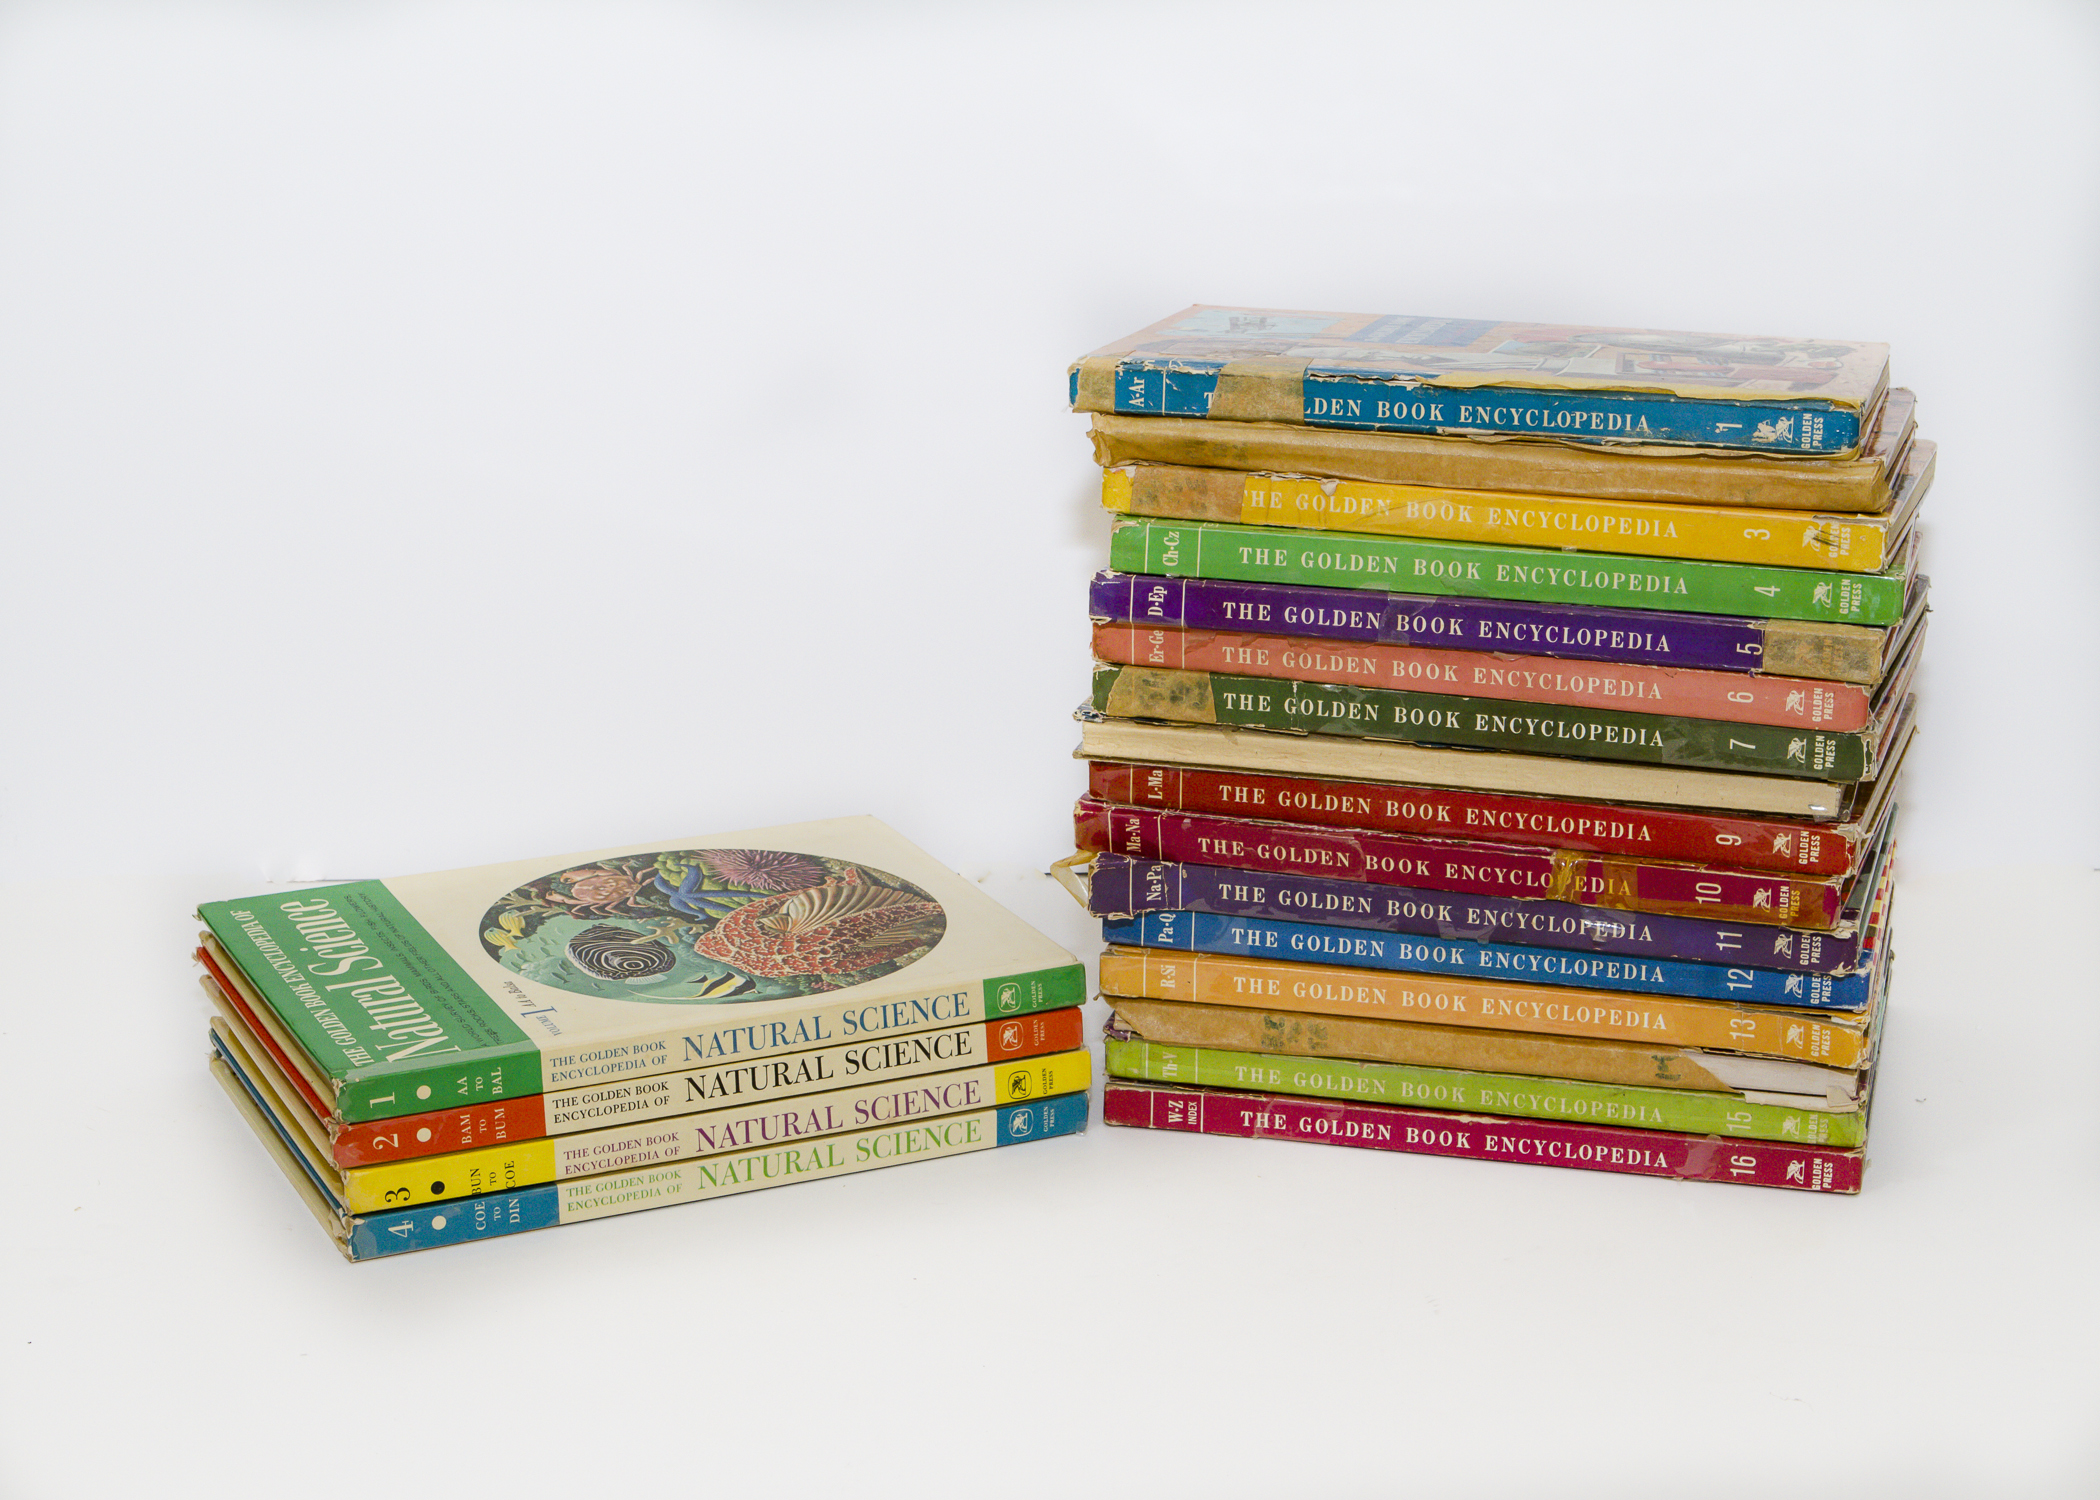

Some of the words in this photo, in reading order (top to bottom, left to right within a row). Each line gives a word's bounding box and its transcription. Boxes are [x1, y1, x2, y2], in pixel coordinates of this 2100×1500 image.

[1377, 401, 1444, 421] BOOK
[1460, 405, 1649, 432] ENCYCLOPEDIA
[1801, 412, 1813, 450] GOLDEN
[1812, 417, 1824, 449] PRESS
[1296, 494, 1391, 516] GOLDEN
[1407, 501, 1474, 522] BOOK
[1488, 507, 1678, 538] ENCYCLOPEDIA
[1743, 528, 1771, 541] 3
[1840, 527, 1851, 556] PRESS
[1239, 547, 1288, 567] THE
[1301, 551, 1399, 574] GOLDEN
[1414, 558, 1482, 580] BOOK
[1496, 564, 1688, 595] ENCYCLOPEDIA
[1754, 585, 1781, 597] 4
[1839, 579, 1851, 615] GOLDEN
[1850, 583, 1862, 612] PRESS
[1222, 602, 1271, 621] THE
[1284, 606, 1381, 630] GOLDEN
[1396, 614, 1463, 636] BOOK
[1478, 620, 1670, 652] ENCYCLOPEDIA
[1736, 643, 1763, 656] 5
[1222, 646, 1269, 666] THE
[1282, 652, 1377, 675] GOLDEN
[1392, 660, 1459, 682] BOOK
[1473, 668, 1662, 700] ENCYCLOPEDIA
[1727, 691, 1754, 704] 6
[1812, 687, 1823, 722] GOLDEN
[1823, 692, 1834, 720] PRESS
[1223, 693, 1271, 712] THE
[1284, 698, 1379, 721] GOLDEN
[1394, 705, 1461, 729] BOOK
[1475, 714, 1664, 747] ENCYCLOPEDIA
[1729, 738, 1756, 750] 7
[1813, 735, 1825, 770] GOLDEN
[1825, 739, 1836, 768] PRESS
[1219, 785, 1266, 805] THE
[1278, 790, 1371, 815] GOLDEN
[1386, 800, 1452, 822] BOOK
[1465, 808, 1652, 841] ENCYCLOPEDIA
[1715, 833, 1742, 846] 9
[1799, 830, 1810, 865] GOLDEN
[1810, 834, 1821, 863] PRESS
[1197, 837, 1245, 856] THE
[1257, 843, 1350, 868] GOLDEN
[1366, 855, 1431, 876] BOOK
[1445, 863, 1632, 896] ENCYCLOEDIA
[1695, 882, 1722, 904] 10
[1778, 885, 1790, 919] GOLDEN
[1790, 889, 1801, 917] PRESS
[230, 911, 254, 921] OF
[1219, 884, 1266, 903] THE
[1278, 889, 1373, 914] GOLDEN
[1387, 900, 1453, 922] BOOK
[1467, 907, 1653, 942] ENCYCLOPEDIA
[241, 920, 305, 983] ENCYCLOPEDIA
[280, 899, 383, 975] Science
[1716, 931, 1743, 952] 11
[1811, 936, 1822, 964] PRESS
[1231, 928, 1278, 948] THE
[1290, 933, 1385, 957] GOLDEN
[1400, 943, 1465, 965] BOOK
[1479, 950, 1665, 983] ENCYCLOPEDIA
[1726, 968, 1754, 991] 12
[1821, 974, 1832, 1003] PRESS
[290, 982, 326, 1008] BOOK
[1233, 976, 1280, 995] THE
[1293, 982, 1386, 1005] GOLDEN
[1401, 990, 1467, 1012] BOOK
[1481, 998, 1667, 1030] ENCYCLOPEDIA
[311, 1009, 356, 1045] GOLDEN
[325, 975, 461, 1063] Natural
[535, 1015, 564, 1035] VOLUME
[682, 1015, 832, 1062] NATURAL
[843, 992, 970, 1035] SCIENCE
[1729, 1018, 1756, 1041] 13
[549, 1055, 577, 1068] THE
[580, 1046, 630, 1065] GOLDEN
[633, 1040, 667, 1054] BOOK
[1810, 1024, 1821, 1057] GOLDEN
[1821, 1028, 1831, 1056] PRESS
[343, 1046, 377, 1066] THE
[550, 1059, 647, 1083] ENCYCLOPEDIA
[651, 1054, 668, 1066] OF
[684, 1055, 834, 1103] NATURAL
[844, 1030, 973, 1076] SCIENCE
[457, 1076, 469, 1096] AA
[475, 1076, 484, 1092] TO
[491, 1067, 503, 1095] BAL
[552, 1096, 579, 1109] THE
[582, 1087, 631, 1105] GOLDEN
[635, 1081, 670, 1096] BOOK
[1235, 1065, 1281, 1085] THE
[1293, 1071, 1386, 1095] GOLDEN
[1401, 1082, 1466, 1103] BOOK
[1480, 1090, 1663, 1123] ENCYCLOPEDIA
[369, 1091, 396, 1109] 1
[553, 1101, 649, 1124] ENCYCLOPEDIA
[654, 1095, 671, 1107] OF
[1187, 1101, 1198, 1125] INDEX
[461, 1113, 472, 1144] BAM
[479, 1119, 487, 1134] TO
[496, 1107, 507, 1140] BUM
[695, 1105, 844, 1153] NATURAL
[854, 1080, 982, 1125] SCIENCE
[1725, 1111, 1752, 1132] 15
[372, 1133, 399, 1151] 2
[563, 1148, 590, 1160] THE
[593, 1138, 642, 1156] GOLDEN
[645, 1132, 680, 1146] BOOK
[1240, 1110, 1287, 1130] THE
[1299, 1116, 1391, 1140] GOLDEN
[1406, 1127, 1471, 1149] BOOK
[1484, 1134, 1668, 1168] ENCYCLOPEDIA
[564, 1152, 659, 1175] ENCYCLOPEDIA
[664, 1146, 681, 1158] OF
[697, 1143, 845, 1190] NATURAL
[856, 1119, 982, 1162] SCIENCE
[1730, 1155, 1757, 1177] 16
[470, 1168, 481, 1195] BUN
[489, 1171, 497, 1186] TO
[505, 1160, 516, 1189] COE
[565, 1186, 592, 1198] THE
[595, 1176, 645, 1194] GOLDEN
[648, 1170, 682, 1184] BOOK
[1812, 1158, 1823, 1190] GOLDEN
[1823, 1162, 1833, 1189] PRESS
[384, 1187, 411, 1203] 3
[567, 1189, 662, 1212] ENCYCLOPEDIA
[667, 1184, 683, 1196] OF
[475, 1201, 487, 1231] COE
[493, 1206, 501, 1221] TO
[509, 1198, 520, 1224] DIN
[388, 1220, 414, 1238] 4
